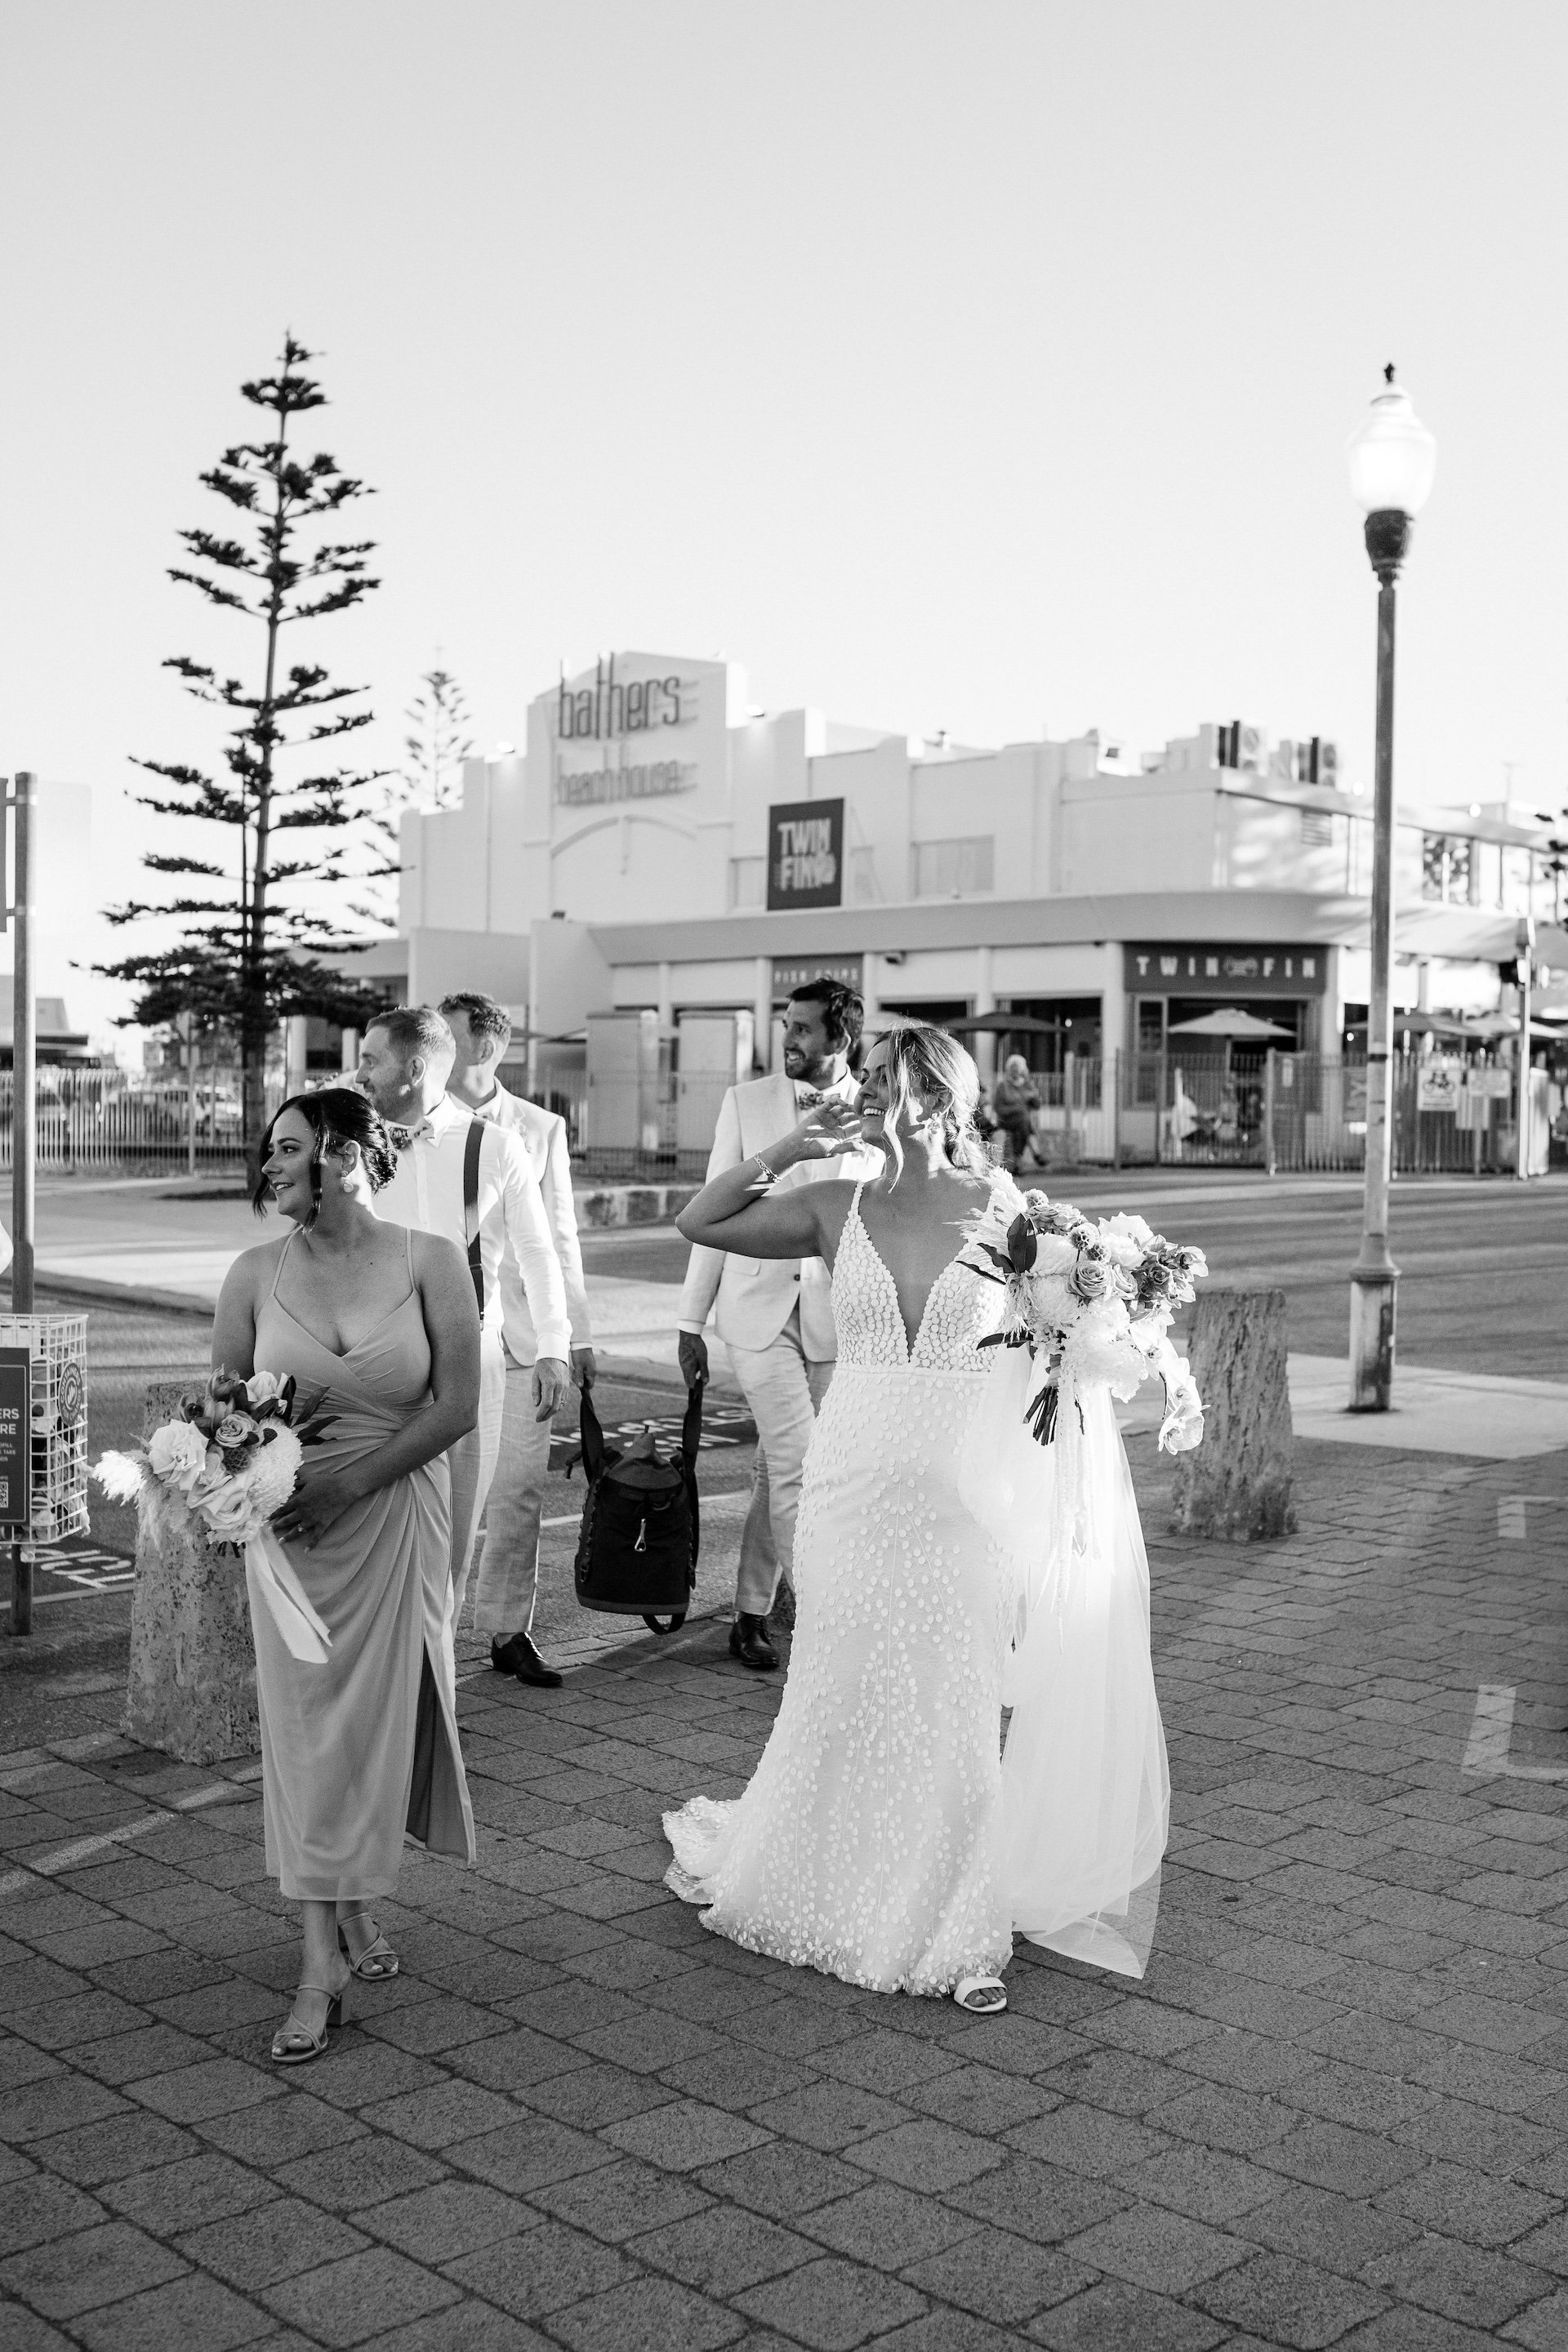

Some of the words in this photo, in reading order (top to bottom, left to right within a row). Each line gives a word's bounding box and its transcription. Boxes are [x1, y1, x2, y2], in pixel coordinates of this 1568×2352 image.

[559, 652, 681, 739] bathers
[777, 818, 831, 856] TWIN
[1136, 956, 1219, 978] TWIN
[1263, 957, 1316, 978] FIN
